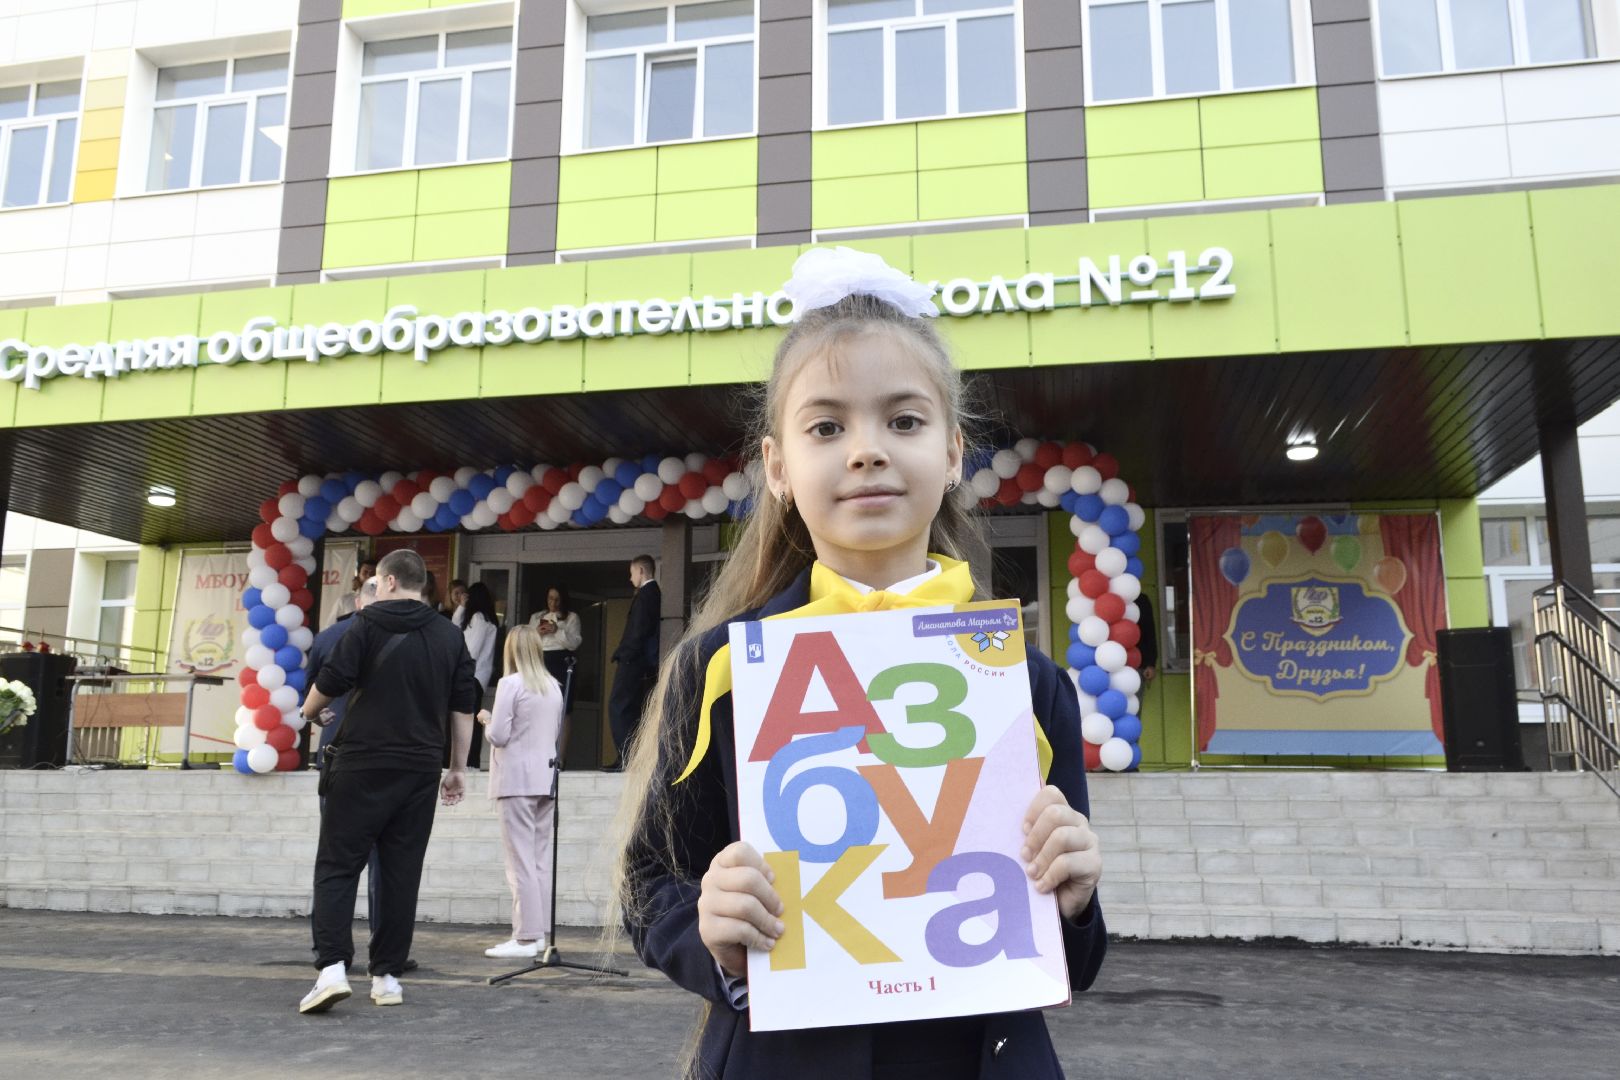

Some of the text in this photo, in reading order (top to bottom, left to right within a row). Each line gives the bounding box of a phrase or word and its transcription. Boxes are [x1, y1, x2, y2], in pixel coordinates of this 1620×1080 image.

[0, 246, 1237, 390] Средняя общеобразовательно ола №12
[195, 572, 250, 593] МБОУ
[918, 616, 1002, 631] Аманатова Марьям
[1240, 631, 1396, 657] С Праздником,
[964, 659, 1005, 678] РОССИИ
[1276, 659, 1366, 686] Друзья!
[868, 976, 937, 996] Часть 1
